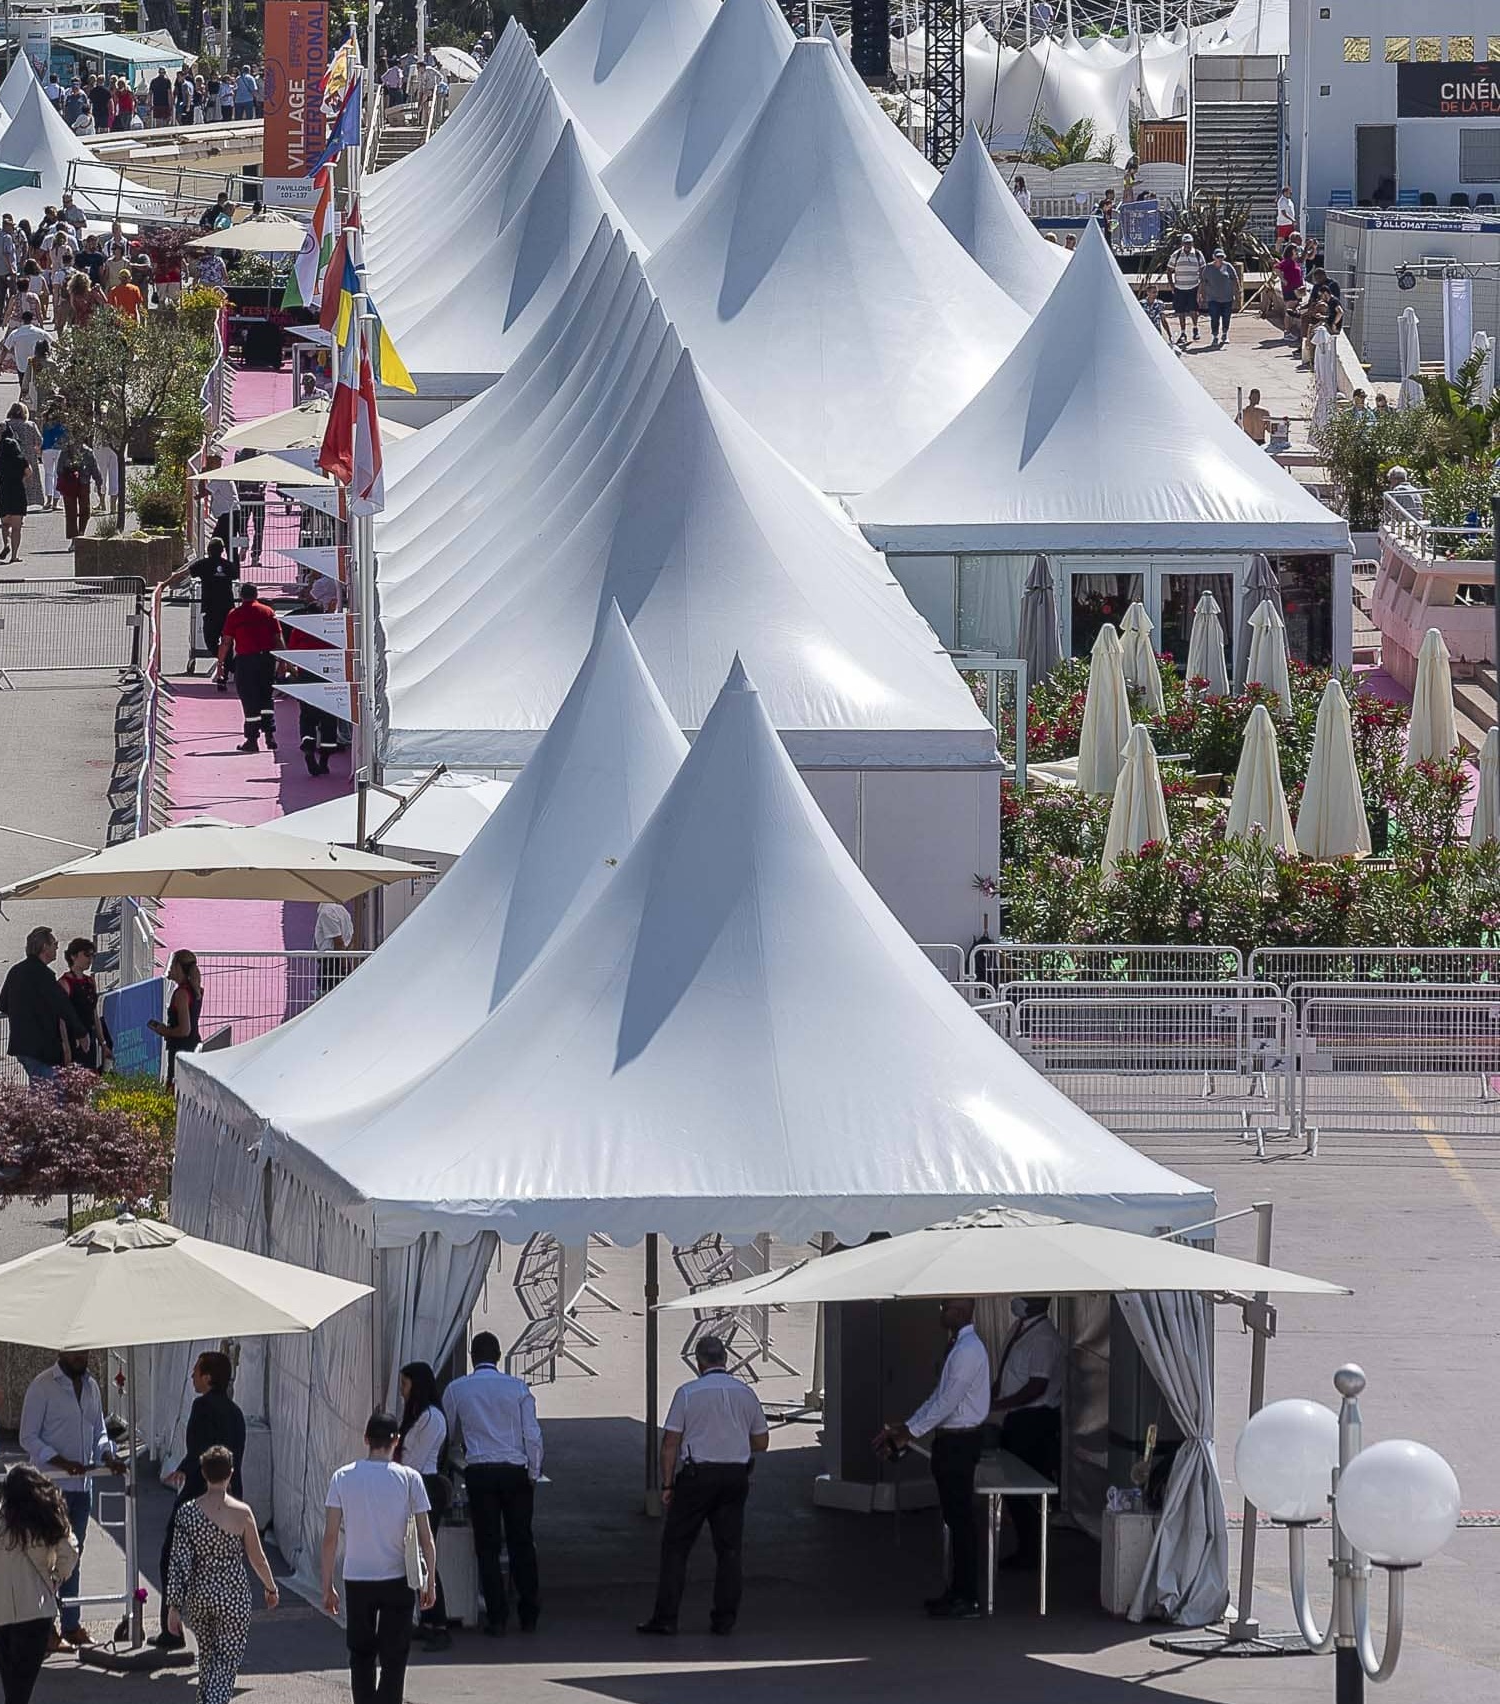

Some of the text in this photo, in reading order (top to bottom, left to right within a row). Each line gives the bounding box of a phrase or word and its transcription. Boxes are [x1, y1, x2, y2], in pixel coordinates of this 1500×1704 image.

[1441, 101, 1458, 112] DE
[1461, 101, 1478, 112] LA
[288, 79, 305, 171] VILLAGE
[276, 184, 312, 192] PAVILLONS
[1383, 220, 1427, 230] ALLOMAT
